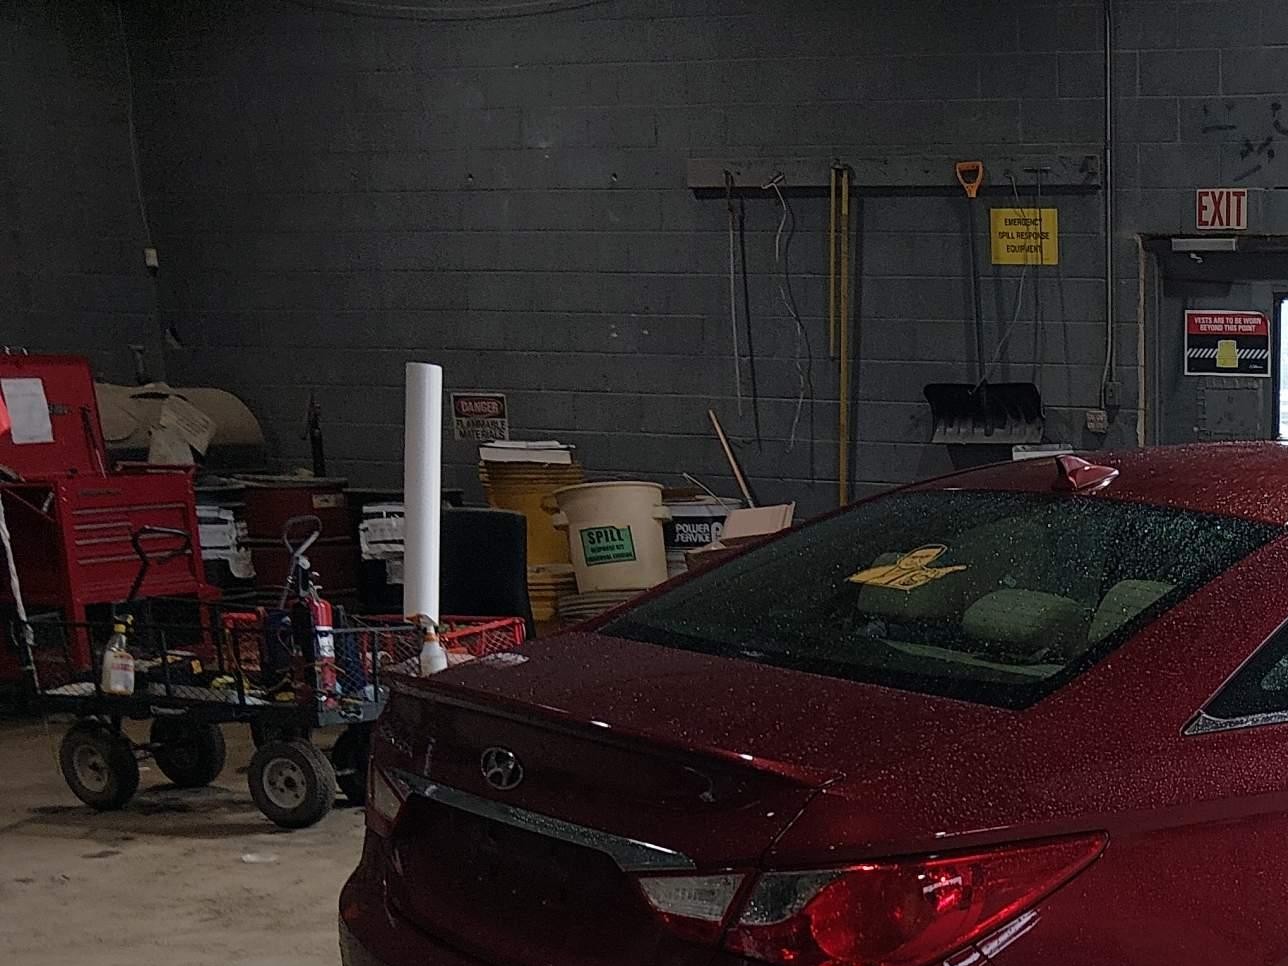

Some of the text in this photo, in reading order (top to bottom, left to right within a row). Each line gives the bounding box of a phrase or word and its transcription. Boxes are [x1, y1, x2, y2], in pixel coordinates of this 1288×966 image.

[1198, 191, 1245, 226] EXIT
[1005, 218, 1042, 226] EMERGENCY
[998, 232, 1050, 240] SPILL RESPONSE
[1007, 244, 1042, 253] EQUIPMENT
[1194, 316, 1212, 324] VESTS
[1226, 317, 1234, 325] TO
[1235, 317, 1243, 325] BE
[1243, 317, 1262, 325] WORN
[1200, 324, 1223, 332] BEYOND
[461, 400, 499, 413] DANGER
[456, 419, 505, 430] FLAMMABLE
[459, 430, 505, 440] MATERIALS
[675, 523, 710, 534] POWER
[587, 529, 624, 544] SPILL
[673, 532, 711, 544] SERVICE
